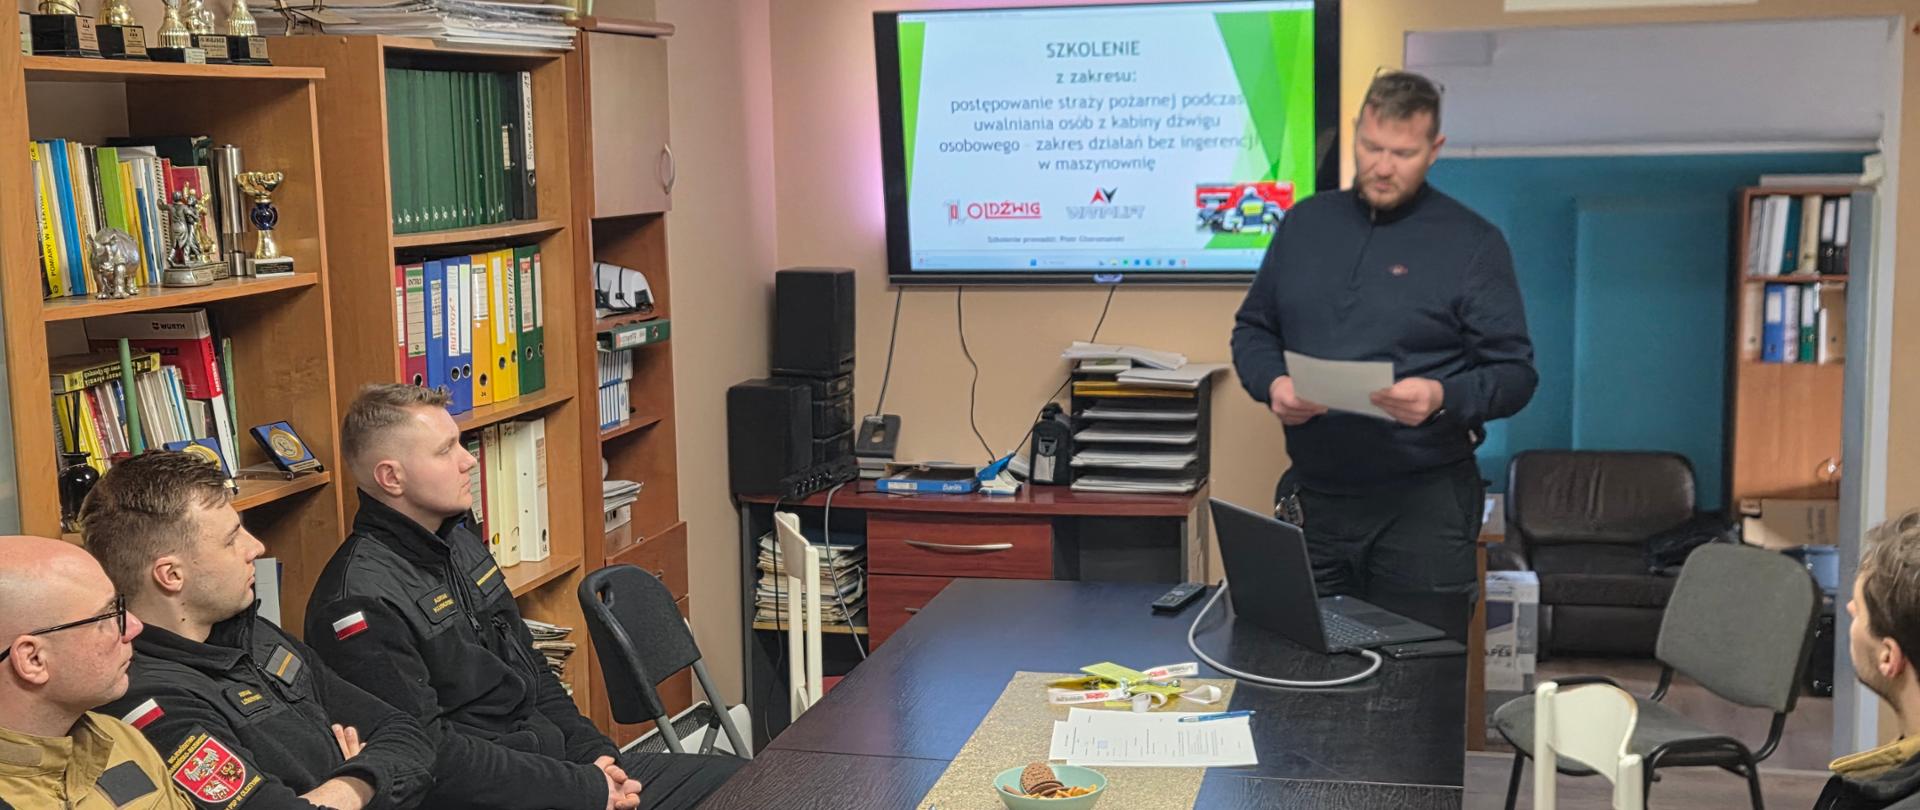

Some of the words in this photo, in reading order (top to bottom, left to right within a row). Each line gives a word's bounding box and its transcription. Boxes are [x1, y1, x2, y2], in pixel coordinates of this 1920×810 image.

[1045, 40, 1141, 58] SZKOLENIE
[1056, 73, 1065, 84] z
[1069, 69, 1137, 84] zakresu:
[950, 96, 1053, 114] postępowanie
[1057, 95, 1104, 111] straży
[1109, 93, 1176, 110] pożarnej
[973, 117, 1054, 131] uwalniania
[1058, 115, 1094, 130] osób
[1098, 118, 1106, 129] z
[1111, 114, 1161, 131] kabiny
[938, 139, 1020, 155] osobowego
[1036, 136, 1084, 151] zakres
[1147, 134, 1176, 149] bez
[1038, 160, 1051, 170] w
[1055, 156, 1156, 173] maszynownię
